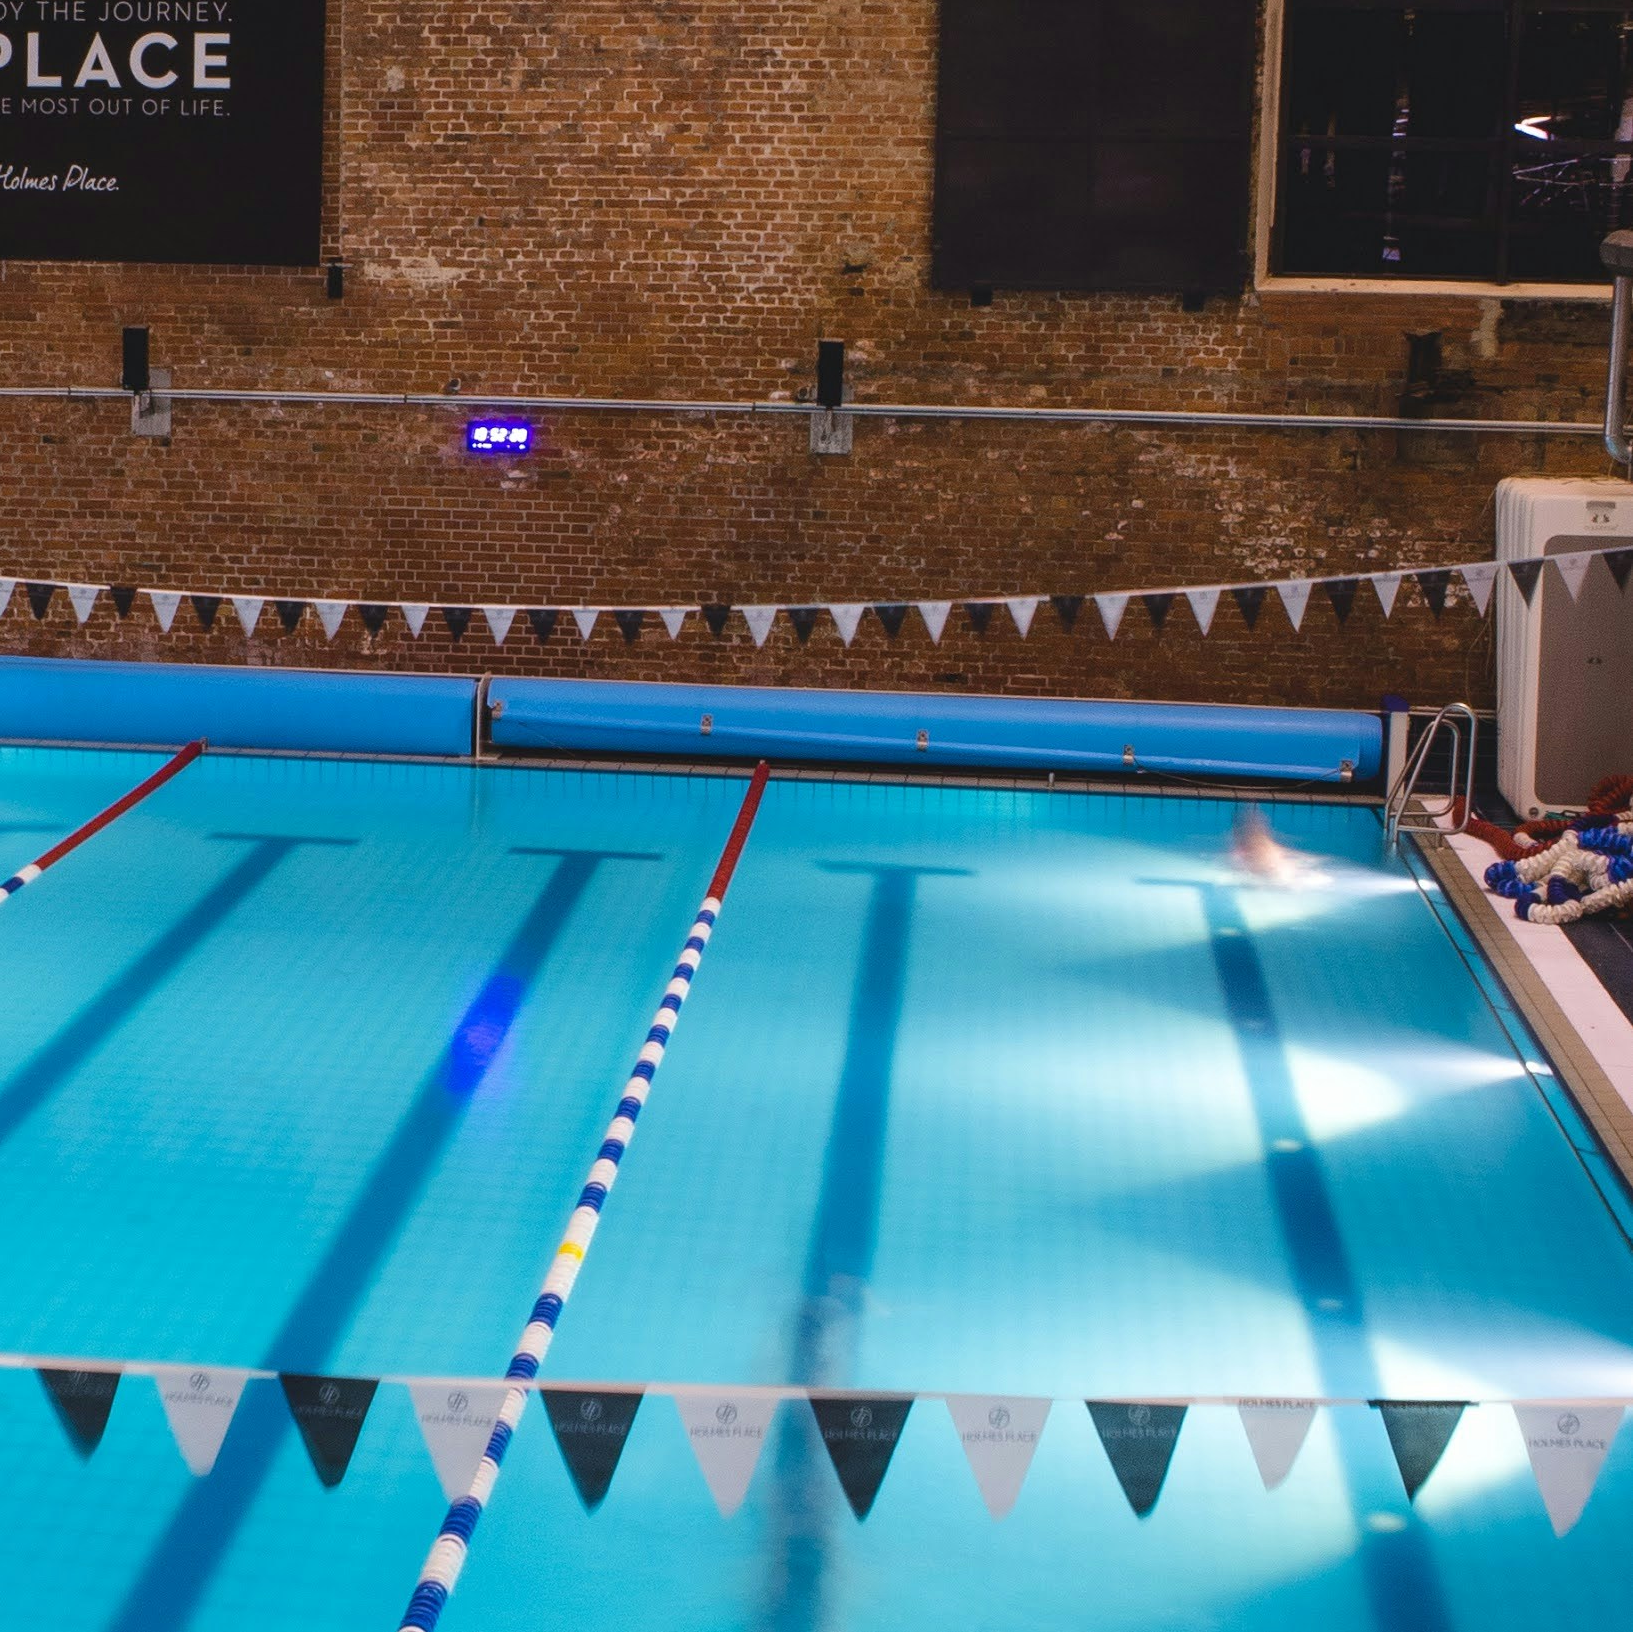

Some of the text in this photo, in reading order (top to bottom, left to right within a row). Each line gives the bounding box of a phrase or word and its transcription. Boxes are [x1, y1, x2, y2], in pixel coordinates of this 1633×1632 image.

[36, 0, 86, 22] THE
[98, 0, 233, 22] JOURNEY.
[21, 97, 81, 115] MOST
[88, 98, 134, 116] OUT
[141, 98, 171, 116] OF
[180, 99, 231, 117] LIFE.
[62, 164, 120, 192] Place.
